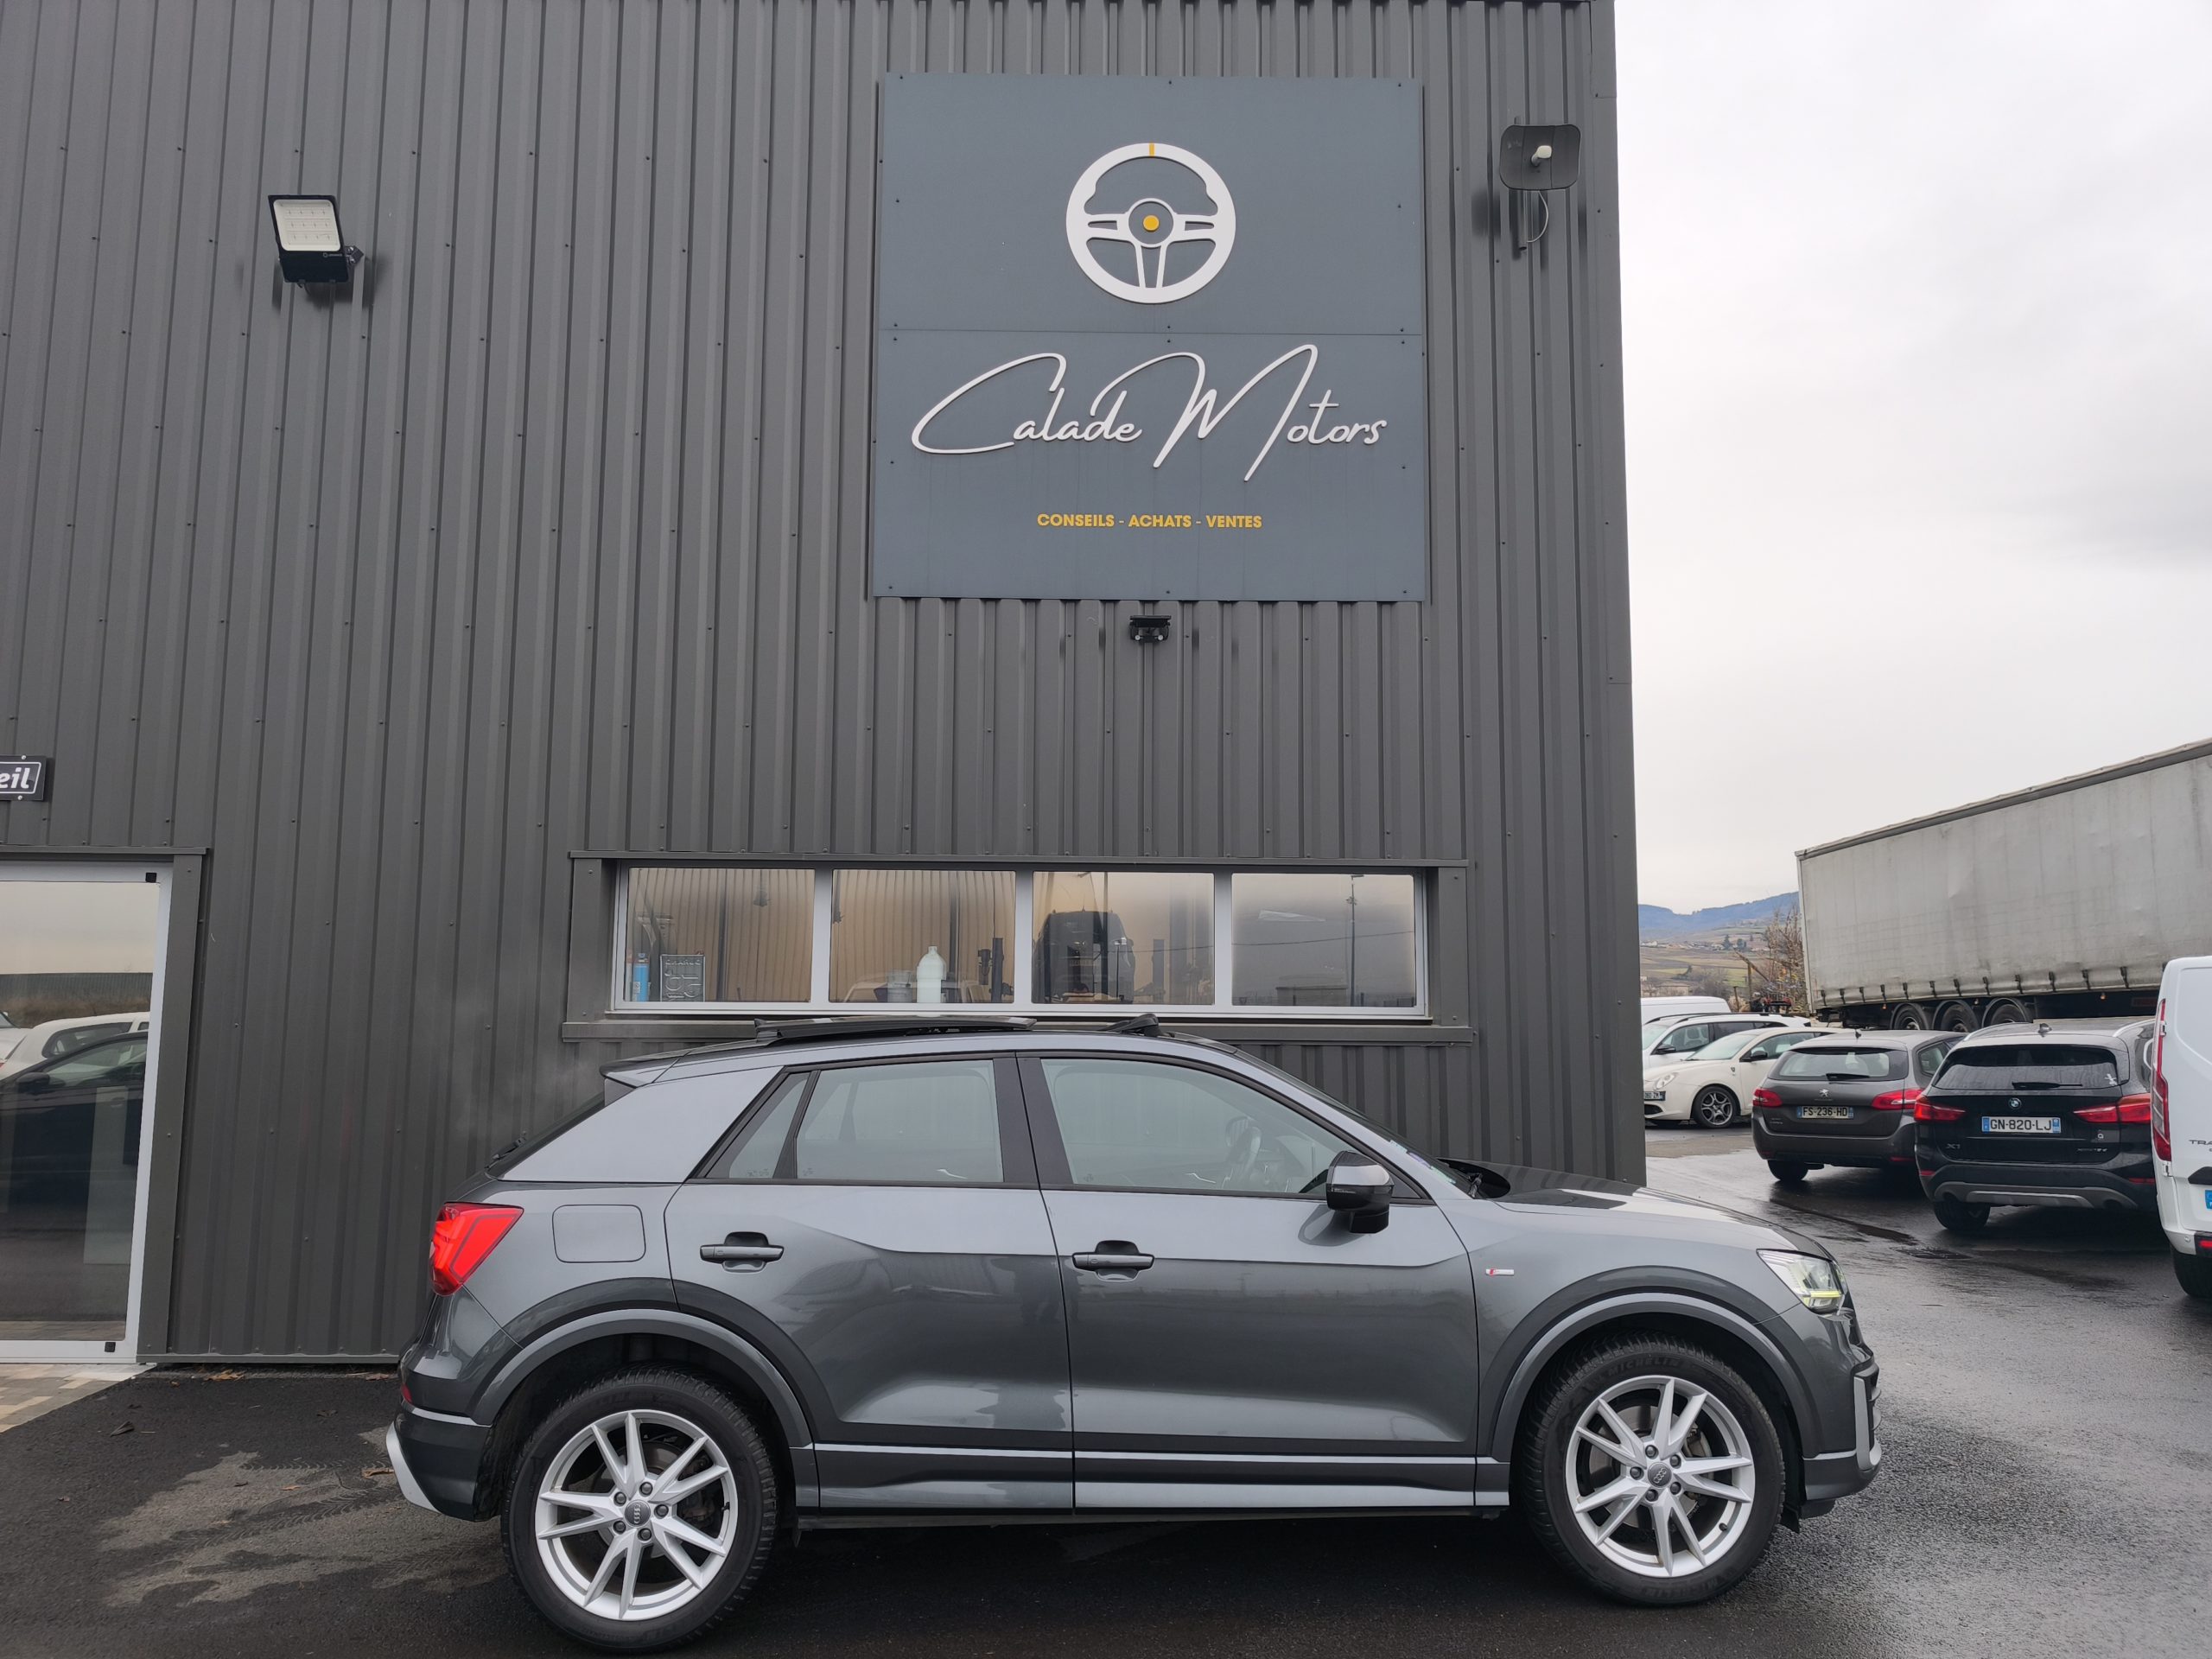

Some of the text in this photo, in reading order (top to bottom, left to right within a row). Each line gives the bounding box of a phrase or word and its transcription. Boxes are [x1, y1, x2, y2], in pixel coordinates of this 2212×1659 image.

[911, 344, 1388, 482] Calade Motors
[1037, 512, 1116, 528] CONSEILS
[1128, 513, 1192, 529] ACHATS
[1205, 514, 1262, 530] VENTES
[1802, 1107, 1848, 1117] FS-236-HD
[1990, 1118, 2052, 1131] GN-820-LJ
